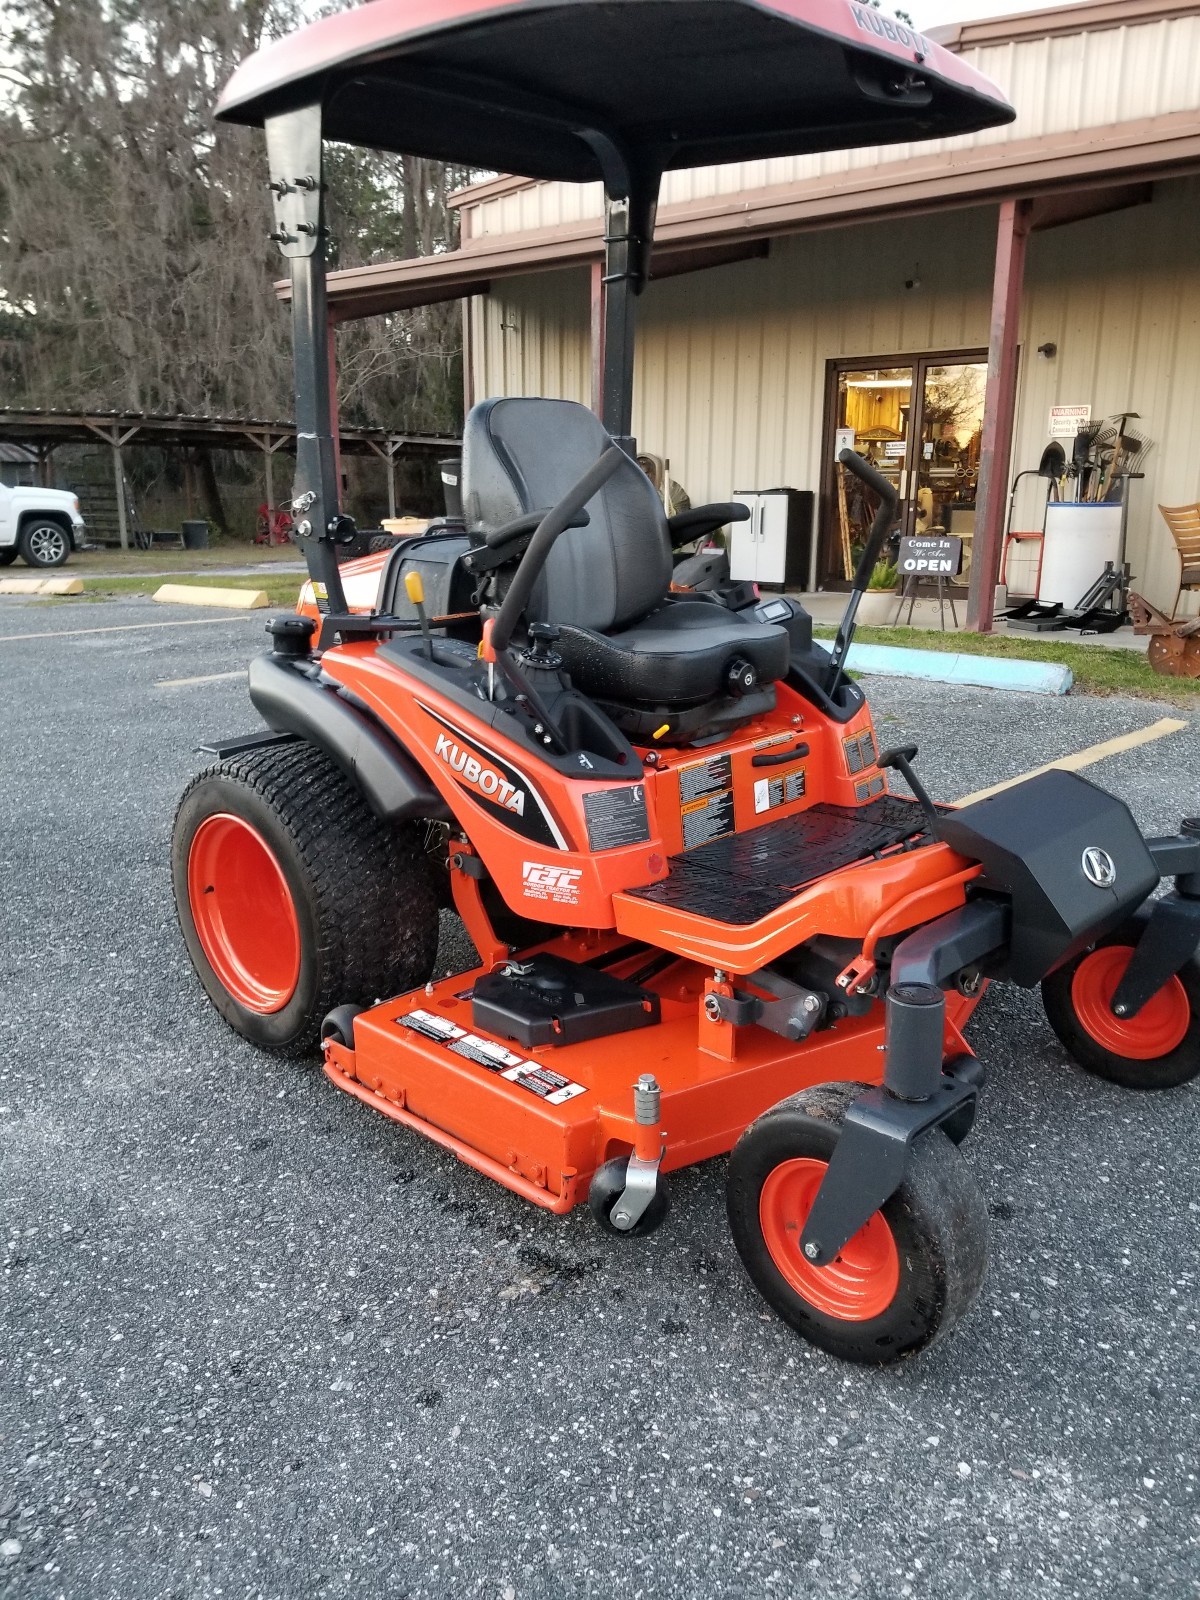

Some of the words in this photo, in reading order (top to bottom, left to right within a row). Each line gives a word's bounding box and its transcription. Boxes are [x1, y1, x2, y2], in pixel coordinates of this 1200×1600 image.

[850, 5, 931, 55] KUBOTA
[1053, 407, 1087, 416] WARNING
[908, 540, 937, 548] Come
[939, 540, 950, 548] In
[913, 549, 926, 557] We
[928, 549, 946, 557] Are
[903, 559, 952, 571] OPEN
[434, 732, 525, 817] KUBOTA
